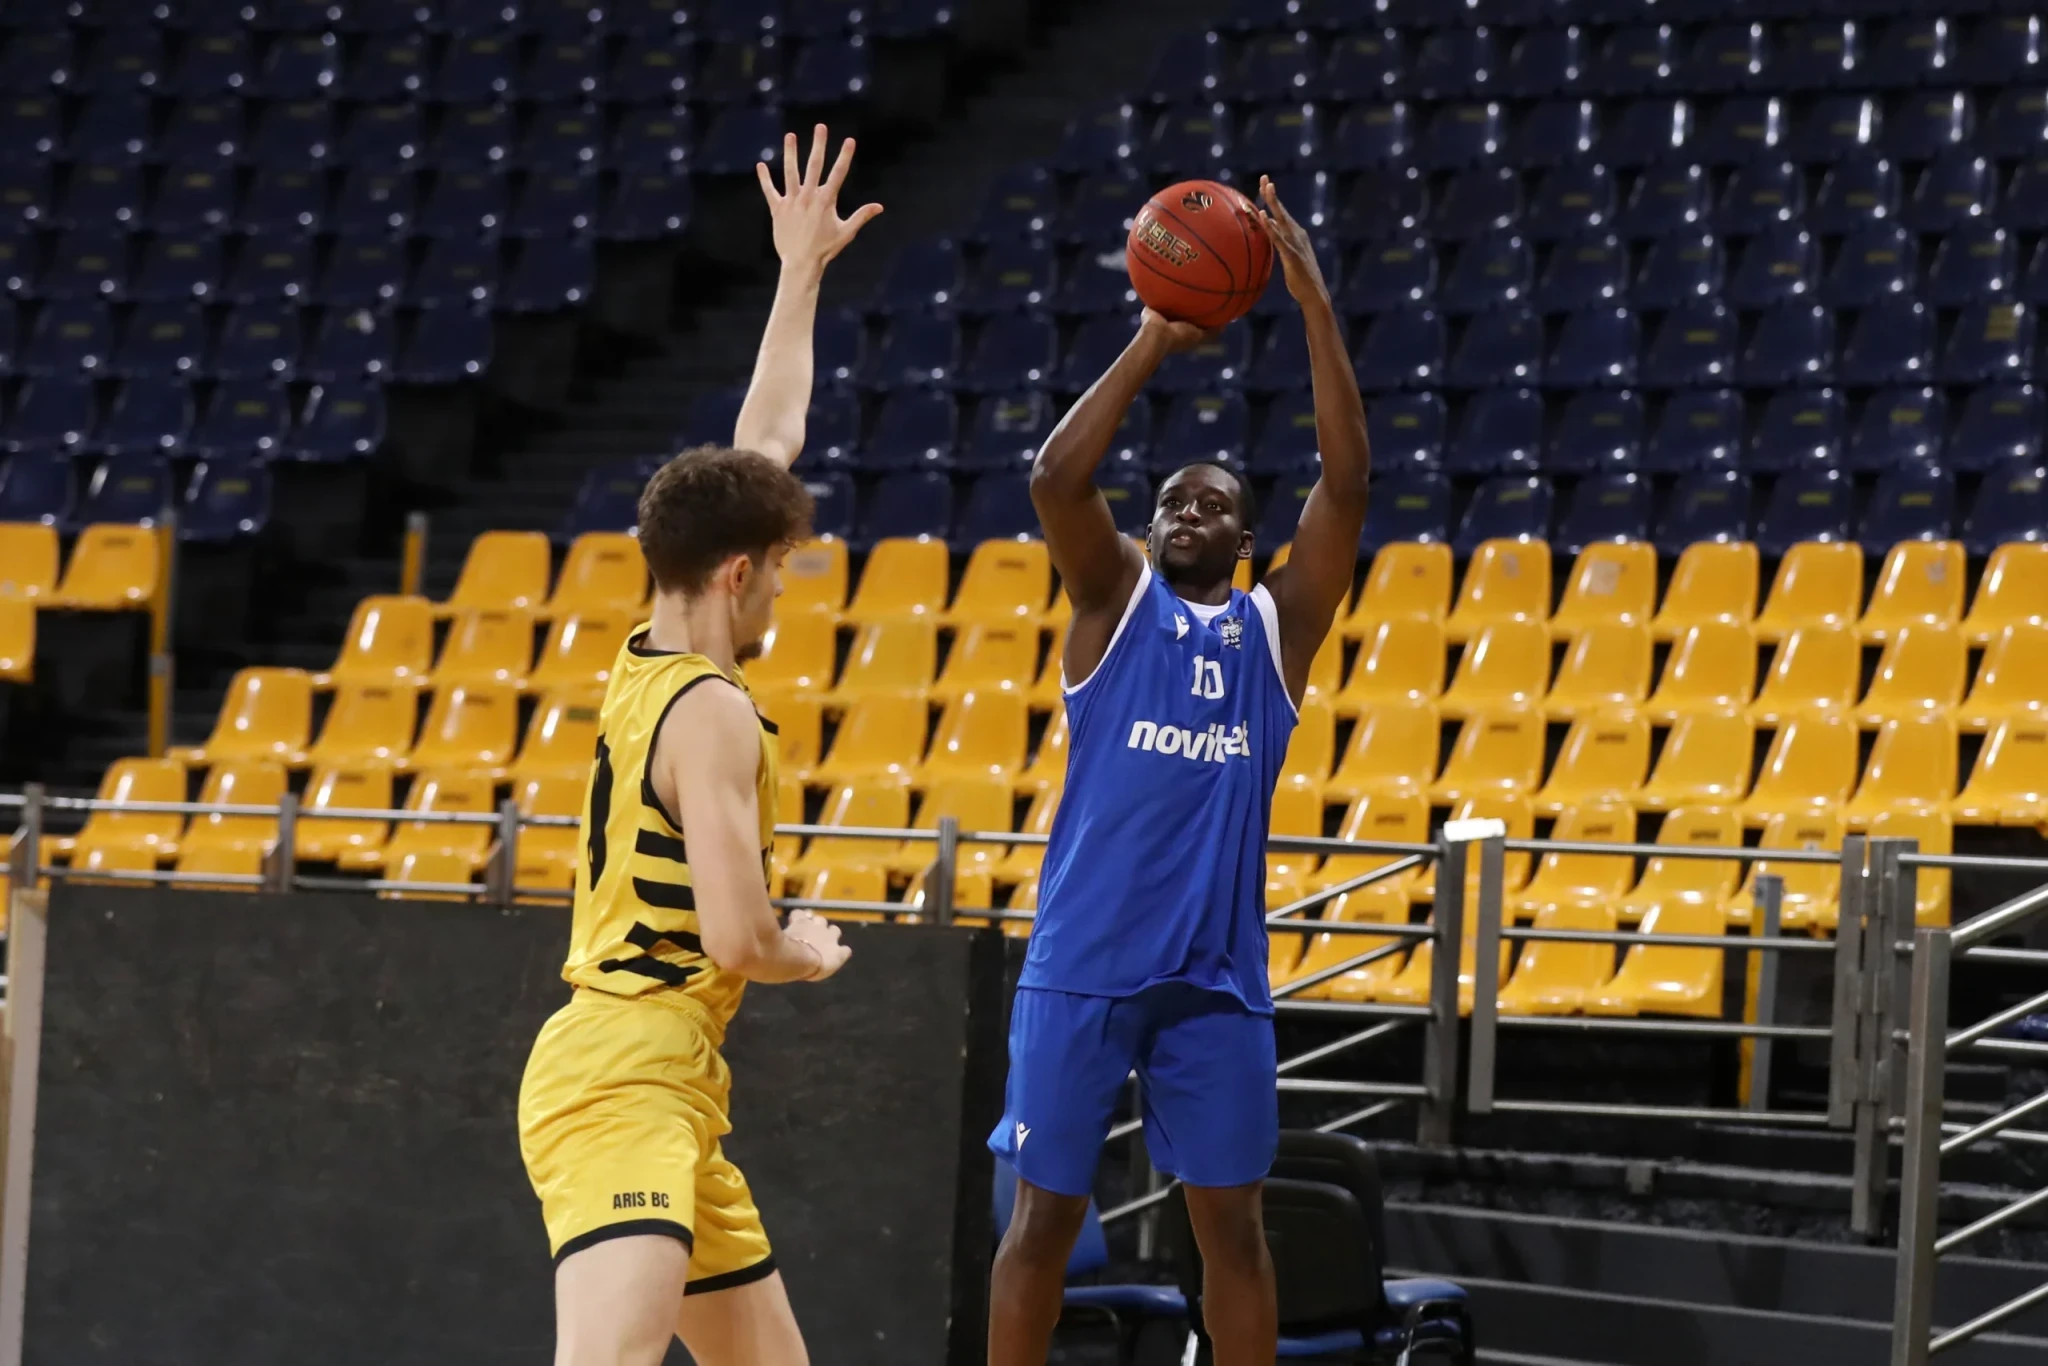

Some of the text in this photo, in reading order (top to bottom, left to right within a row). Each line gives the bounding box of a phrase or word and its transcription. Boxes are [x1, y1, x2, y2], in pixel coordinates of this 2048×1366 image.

[1191, 654, 1225, 700] 10
[613, 1191, 670, 1210] ARIS BC
